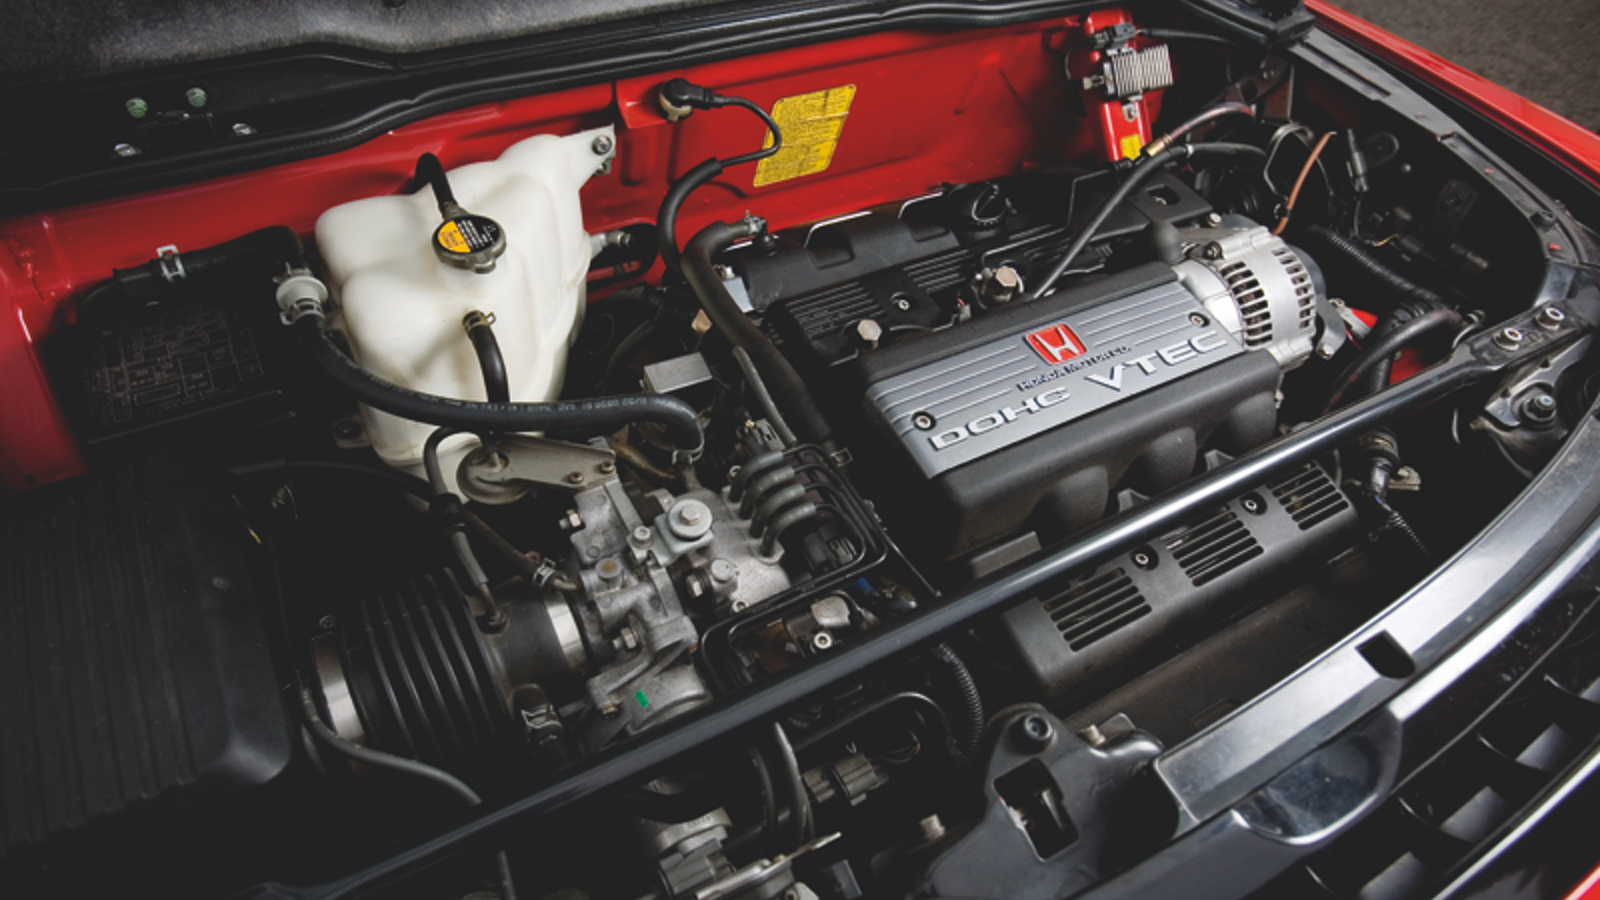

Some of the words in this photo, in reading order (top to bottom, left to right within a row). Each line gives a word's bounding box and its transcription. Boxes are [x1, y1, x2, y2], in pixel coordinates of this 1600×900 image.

[928, 386, 1071, 451] DOHC
[1083, 329, 1228, 392] VTEC
[1016, 369, 1065, 392] HONDA
